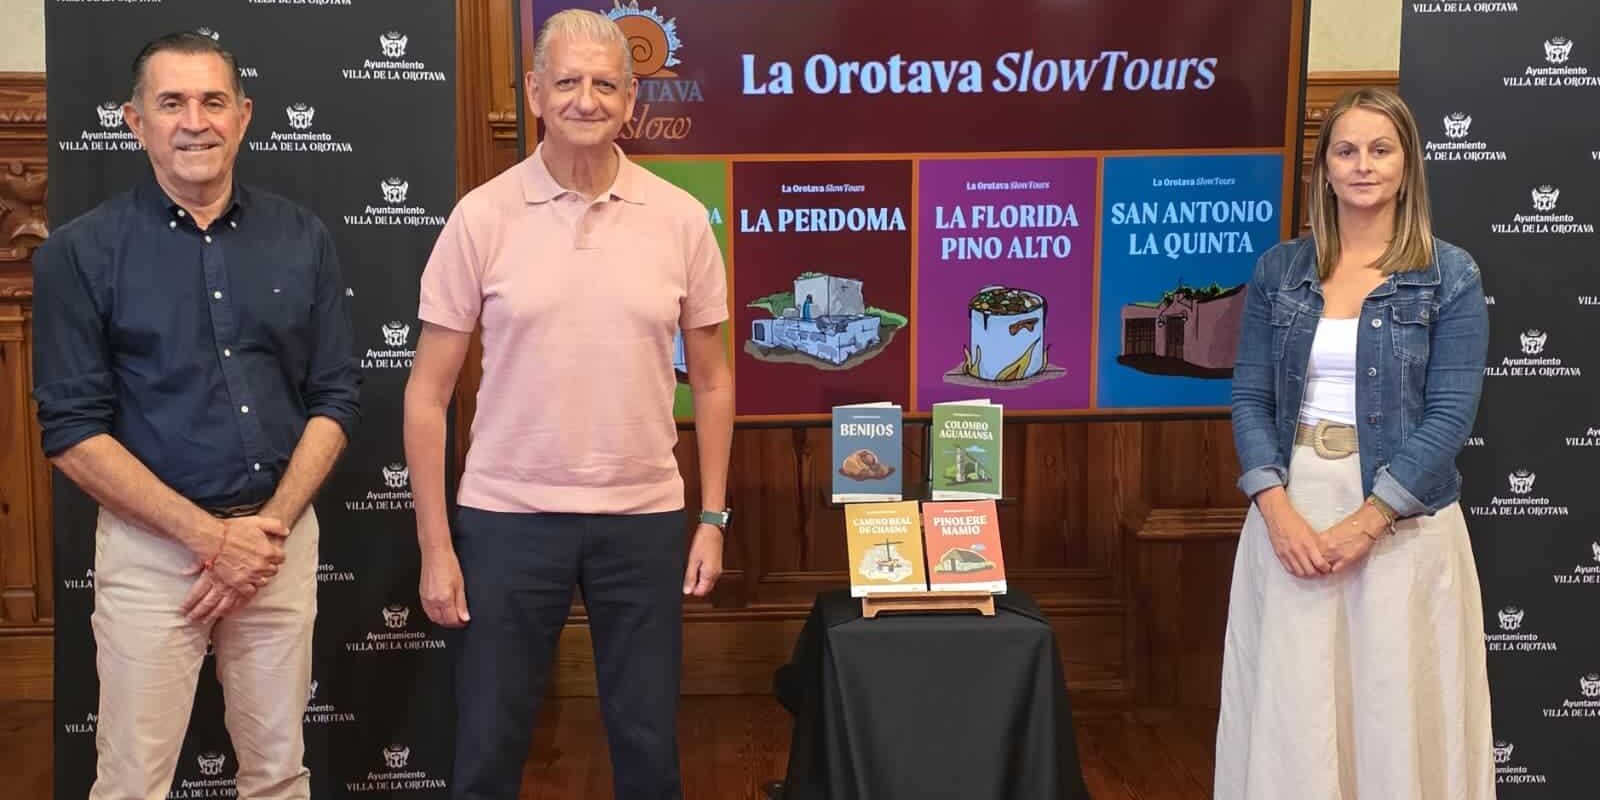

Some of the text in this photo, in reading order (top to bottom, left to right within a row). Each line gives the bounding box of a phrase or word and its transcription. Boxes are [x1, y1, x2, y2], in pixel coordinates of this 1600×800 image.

[1413, 2, 1518, 12] VILLA DE LA OROTAVA
[364, 59, 424, 70] Ayuntamiento
[342, 70, 446, 81] VILLA DE LA OROTAVA
[741, 48, 1218, 95] La Orotava SlowTours
[1526, 66, 1587, 76] Ayuntamiento
[1504, 76, 1600, 86] VILLA DE LA OROTAV
[638, 80, 704, 102] TAVA
[82, 130, 134, 140] Ayuntamien
[270, 132, 332, 142] Ayuntamiento
[59, 141, 86, 150] VILLA
[91, 142, 104, 150] DE
[105, 142, 118, 150] LA
[250, 142, 352, 152] VILLA DE LA OROTAVA
[1426, 142, 1486, 152] Ayuntamiento
[1434, 152, 1447, 160] DE
[1449, 152, 1461, 160] LA
[1464, 152, 1507, 162] OROTAVA
[966, 182, 976, 190] La
[1153, 178, 1162, 186] La
[782, 184, 792, 192] La
[365, 206, 424, 216] Ayuntamiento
[1112, 200, 1273, 225] SAN ANTONIO
[344, 216, 446, 226] VILLA DE LA OROTAVA
[740, 208, 773, 232] LA
[778, 208, 906, 232] PERDOMA
[936, 204, 1078, 229] LA FLORIDA
[1514, 214, 1574, 224] Ayuntamiento
[1492, 224, 1594, 234] VILLA DE LA OROTAVA
[942, 236, 1072, 260] PINO ALTO
[1130, 232, 1254, 259] LA QUINTA
[1578, 296, 1600, 304] VILL
[376, 360, 388, 368] DE
[390, 360, 402, 368] LA
[1502, 356, 1560, 366] Ayuntamiento
[1510, 368, 1523, 376] DE
[1524, 368, 1536, 376] LA
[1538, 368, 1580, 376] OROTAVA
[840, 424, 894, 439] BENIJOS
[1566, 437, 1592, 446] VILLA
[346, 502, 373, 510] VILLA
[376, 502, 389, 510] DE
[390, 502, 402, 510] LA
[1491, 496, 1550, 506] Ayuntamiento
[1470, 506, 1568, 516] VILLA DE LA OROTAVA
[933, 515, 987, 526] PINOLERE
[942, 526, 980, 536] MAMIO
[64, 580, 92, 588] VILLA
[1554, 575, 1580, 584] VILLA
[1583, 575, 1595, 584] DE
[366, 632, 425, 641] Ayuntamiento
[346, 642, 373, 651] VILLA
[390, 641, 400, 650] LA
[1516, 642, 1557, 652] OROTAVA
[1543, 708, 1568, 717] VILLA
[1572, 708, 1583, 717] DE
[1584, 708, 1594, 717] LA
[65, 724, 94, 732] VILLA
[368, 771, 426, 780] Ayuntamiento
[1506, 775, 1546, 784] OROTAVA
[346, 783, 374, 792] VILLA
[390, 782, 401, 790] LA
[206, 789, 217, 798] LA
